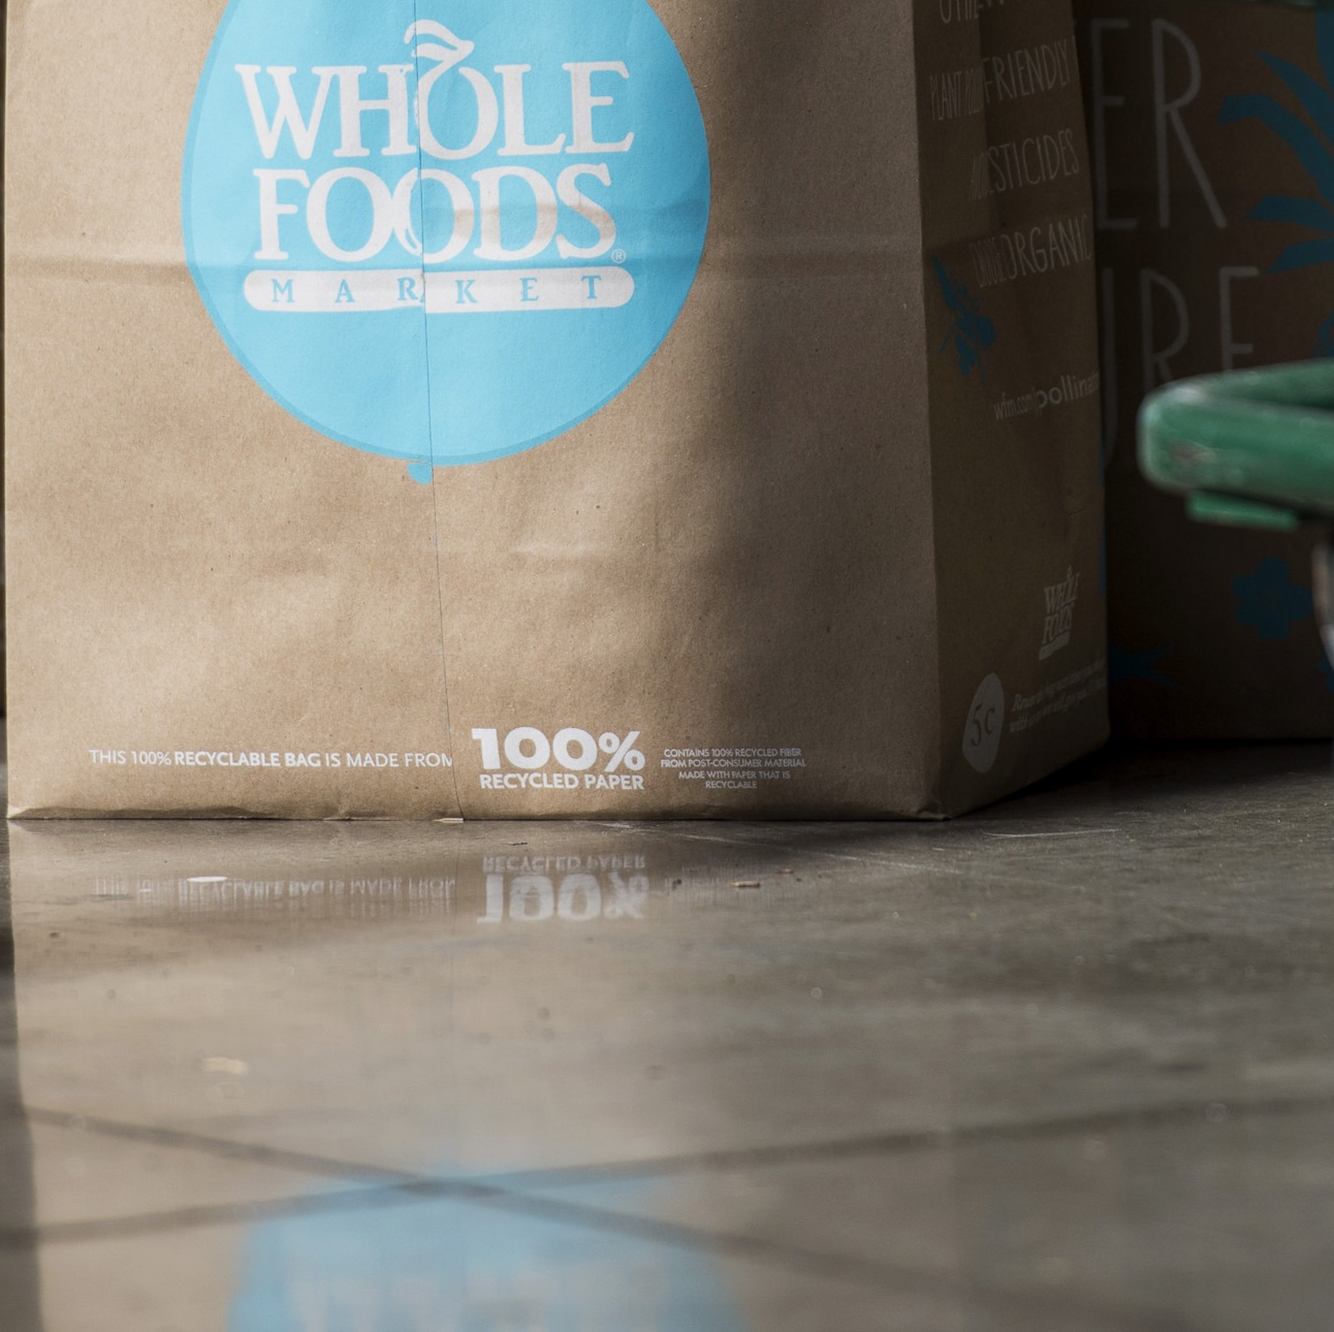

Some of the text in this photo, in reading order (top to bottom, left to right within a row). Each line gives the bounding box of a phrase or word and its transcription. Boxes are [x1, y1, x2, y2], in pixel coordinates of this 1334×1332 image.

[234, 37, 635, 160] WHOLE
[272, 275, 602, 304] MARKET
[471, 726, 646, 772] 100%
[664, 748, 802, 758] CONTAINS 100% RECYCLED FIBER
[88, 749, 453, 768] THIS 100% RECYCLABLE BAG IS MADE FROM
[661, 759, 806, 768] FROM POST-CONSUMER MATERIAL
[479, 773, 645, 791] RECYCLED PAPER
[679, 770, 790, 779] MADE WITH PAPER THAT IS
[705, 780, 757, 789] RECYCLABLE
